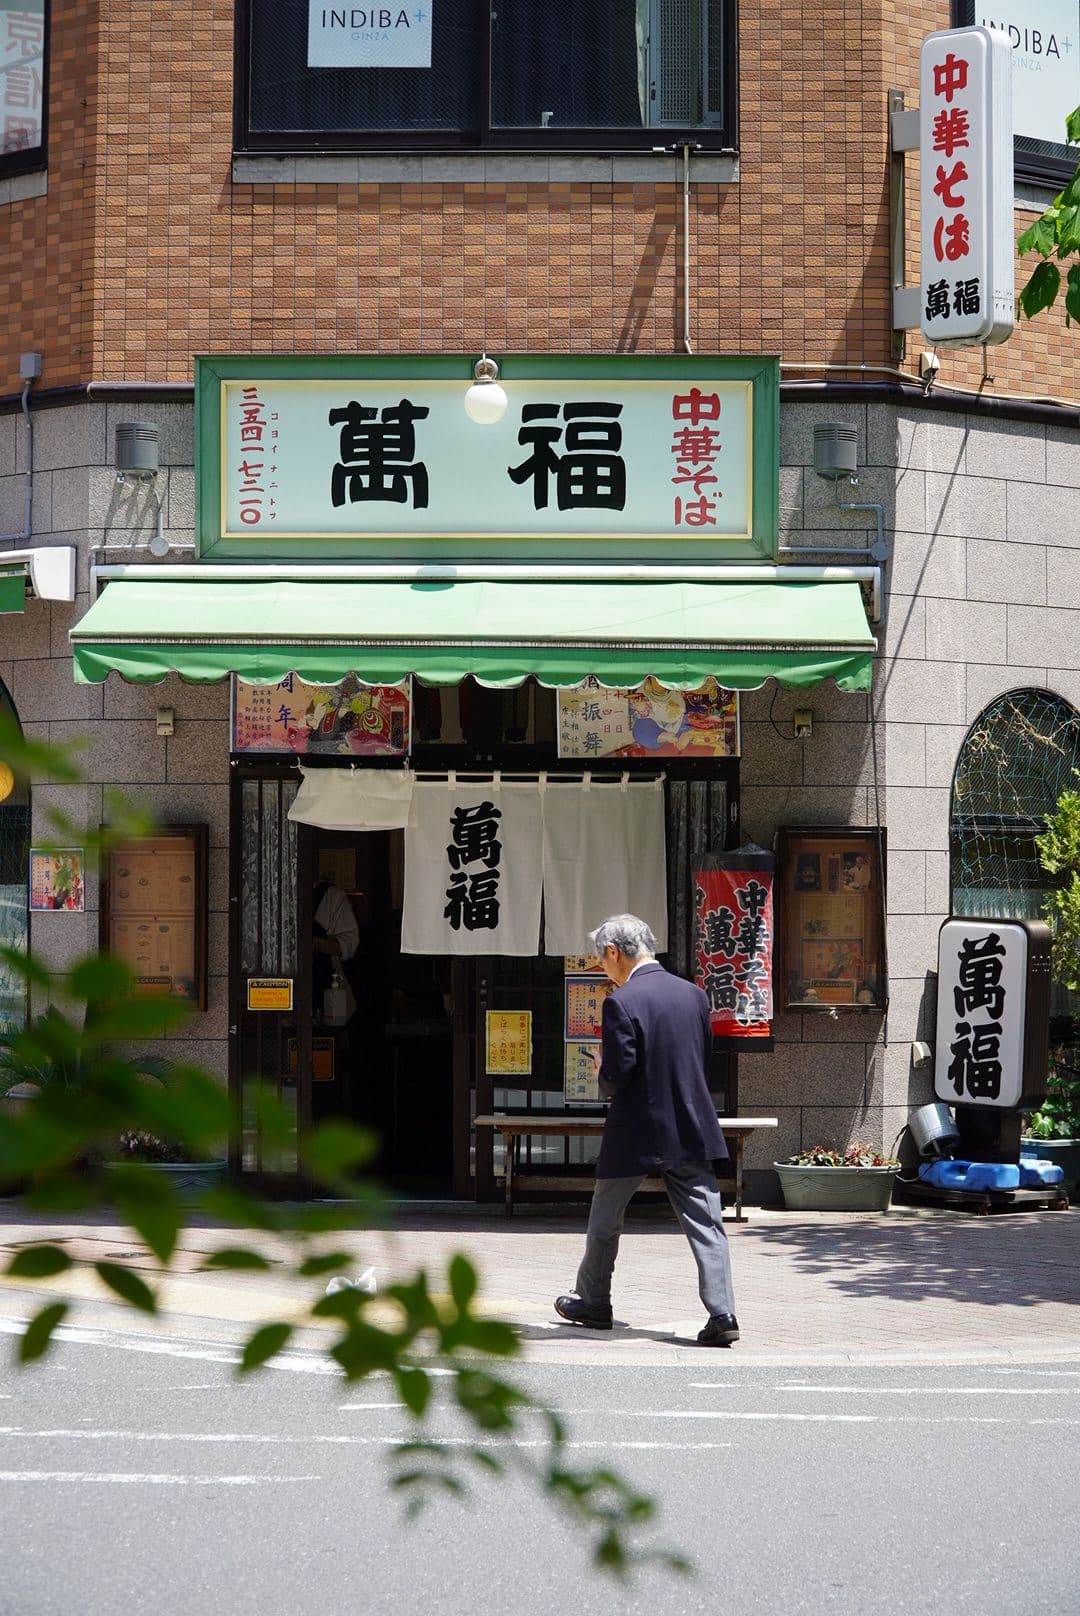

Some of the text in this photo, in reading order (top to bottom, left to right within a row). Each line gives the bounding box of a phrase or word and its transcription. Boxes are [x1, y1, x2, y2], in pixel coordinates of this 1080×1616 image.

[351, 31, 389, 41] GINZA
[932, 52, 970, 263] 中華そば
[925, 277, 980, 321] 萬福
[671, 387, 723, 527] 中華そば
[443, 800, 503, 932] 萬福
[704, 907, 739, 1012] 萬福
[735, 879, 770, 1026] 中華そば
[947, 932, 1007, 1100] 萬福
